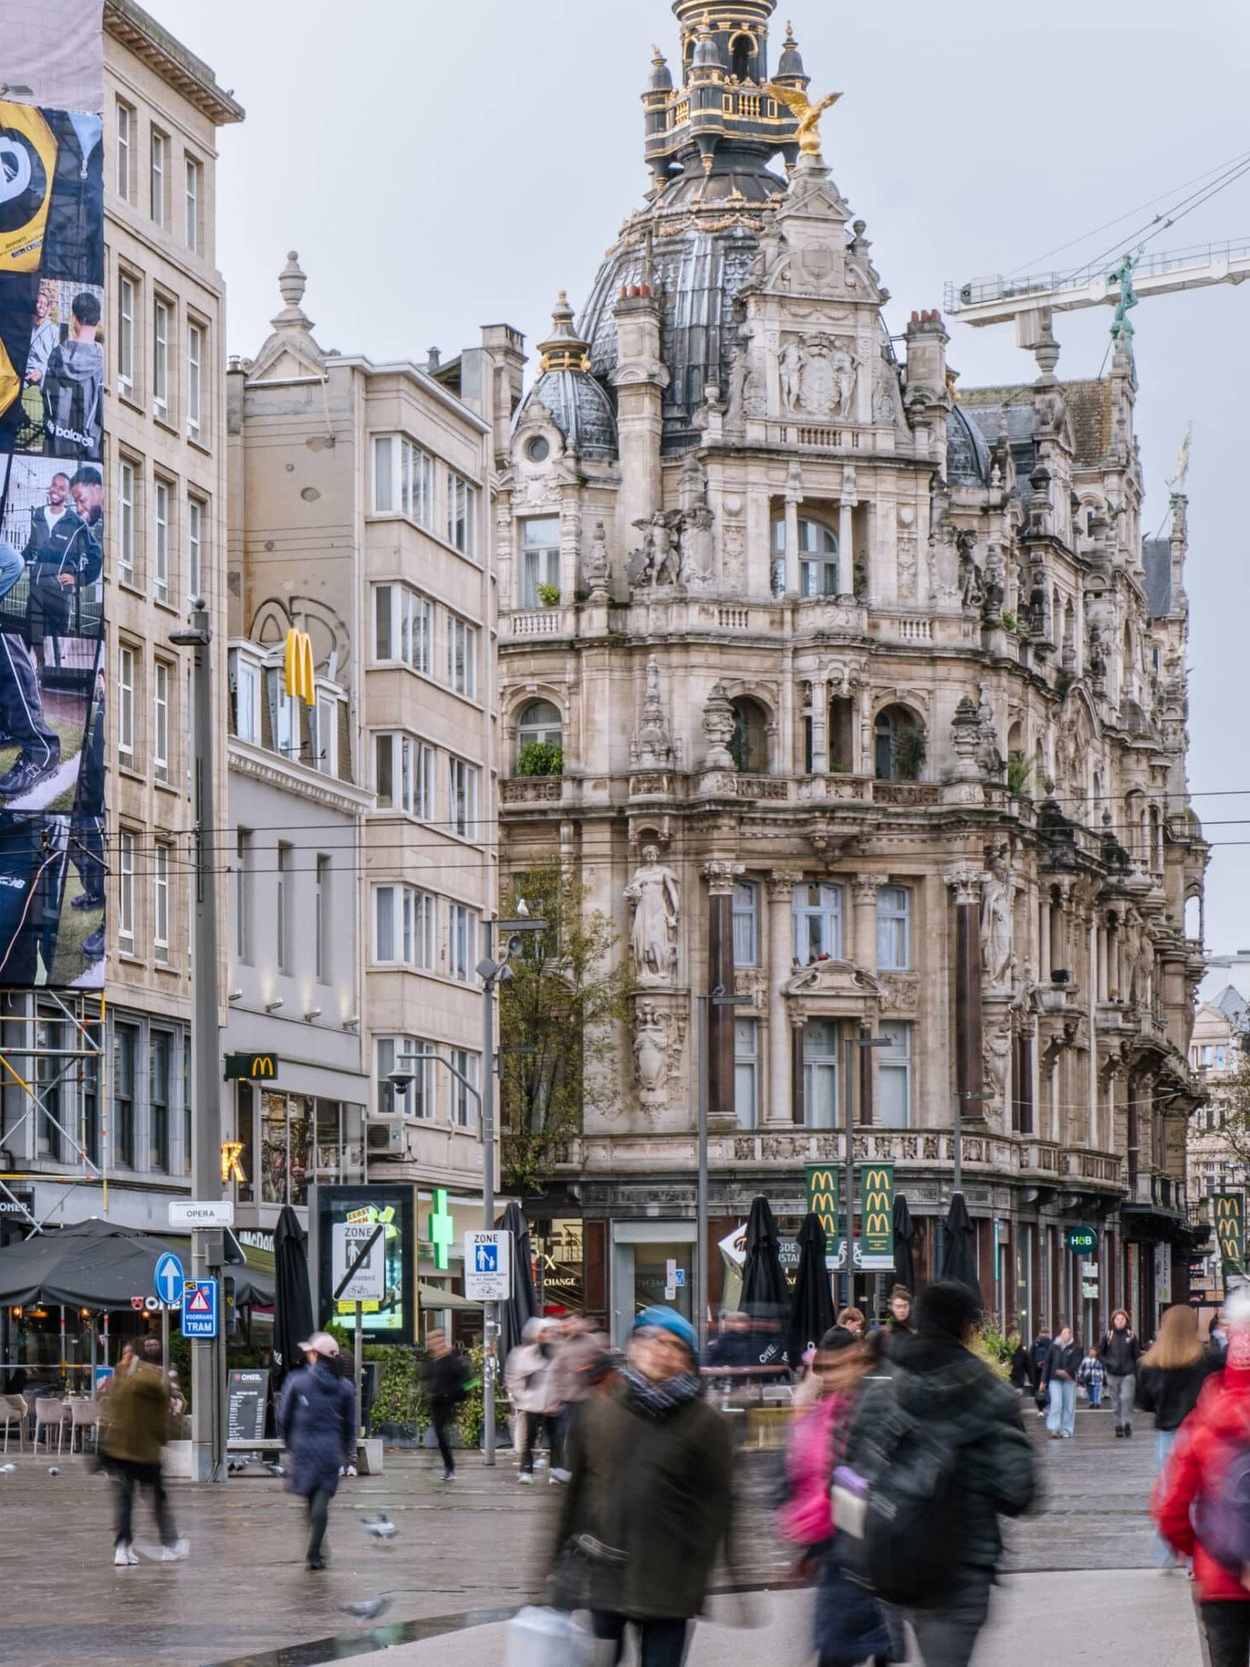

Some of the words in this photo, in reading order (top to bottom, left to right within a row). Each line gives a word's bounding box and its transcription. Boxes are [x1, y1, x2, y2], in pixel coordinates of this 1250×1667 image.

[186, 1210, 215, 1218] OPERA
[344, 1228, 372, 1238] ZONE
[243, 1231, 275, 1252] McDon
[474, 1234, 498, 1244] ZONE
[187, 1323, 212, 1332] TRAM
